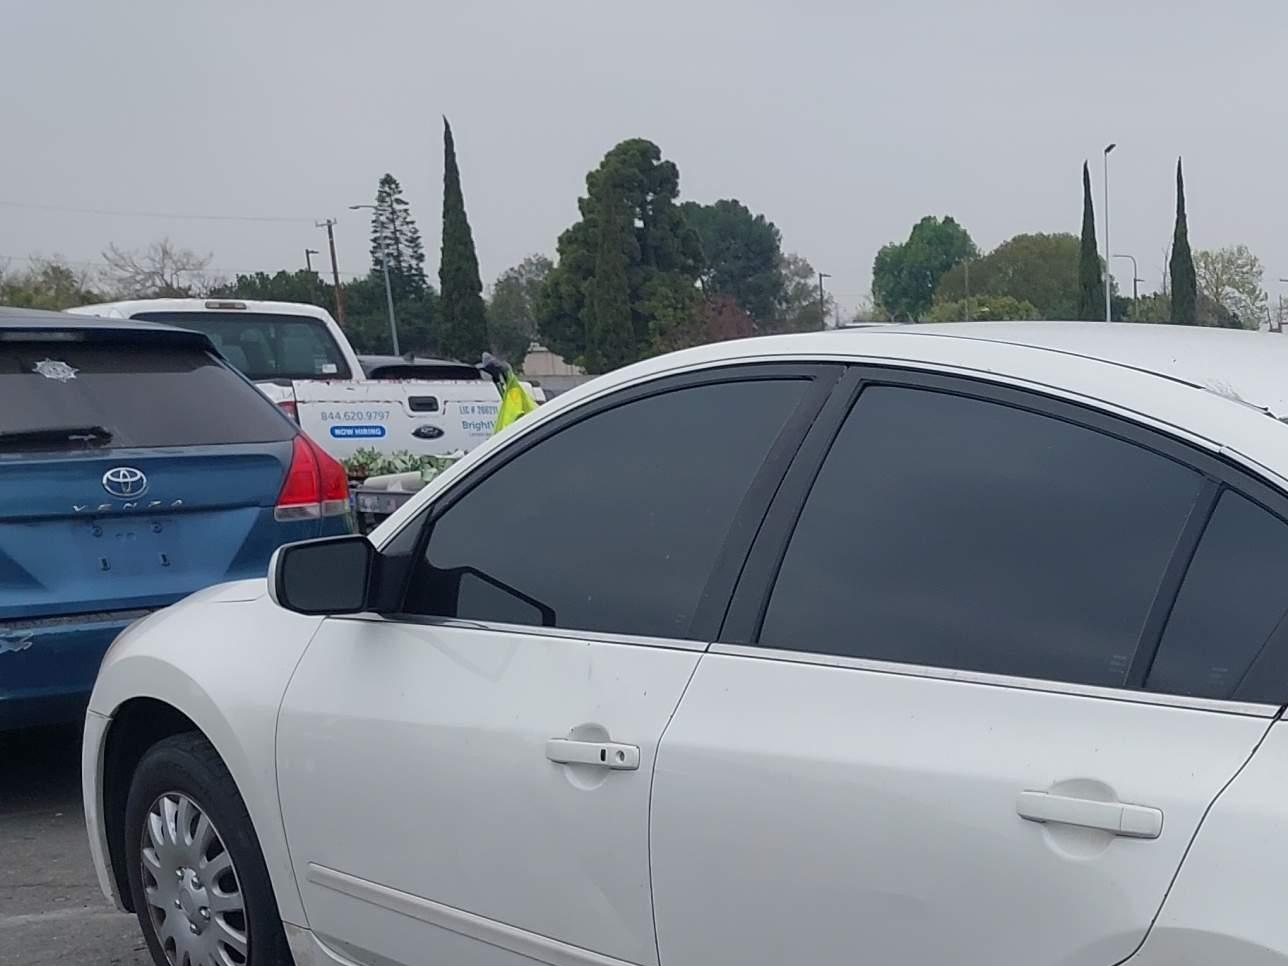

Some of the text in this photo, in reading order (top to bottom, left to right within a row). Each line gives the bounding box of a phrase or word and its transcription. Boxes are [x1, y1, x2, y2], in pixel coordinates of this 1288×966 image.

[320, 411, 390, 421] 844.620.9797
[334, 428, 382, 436] NOW HIRING
